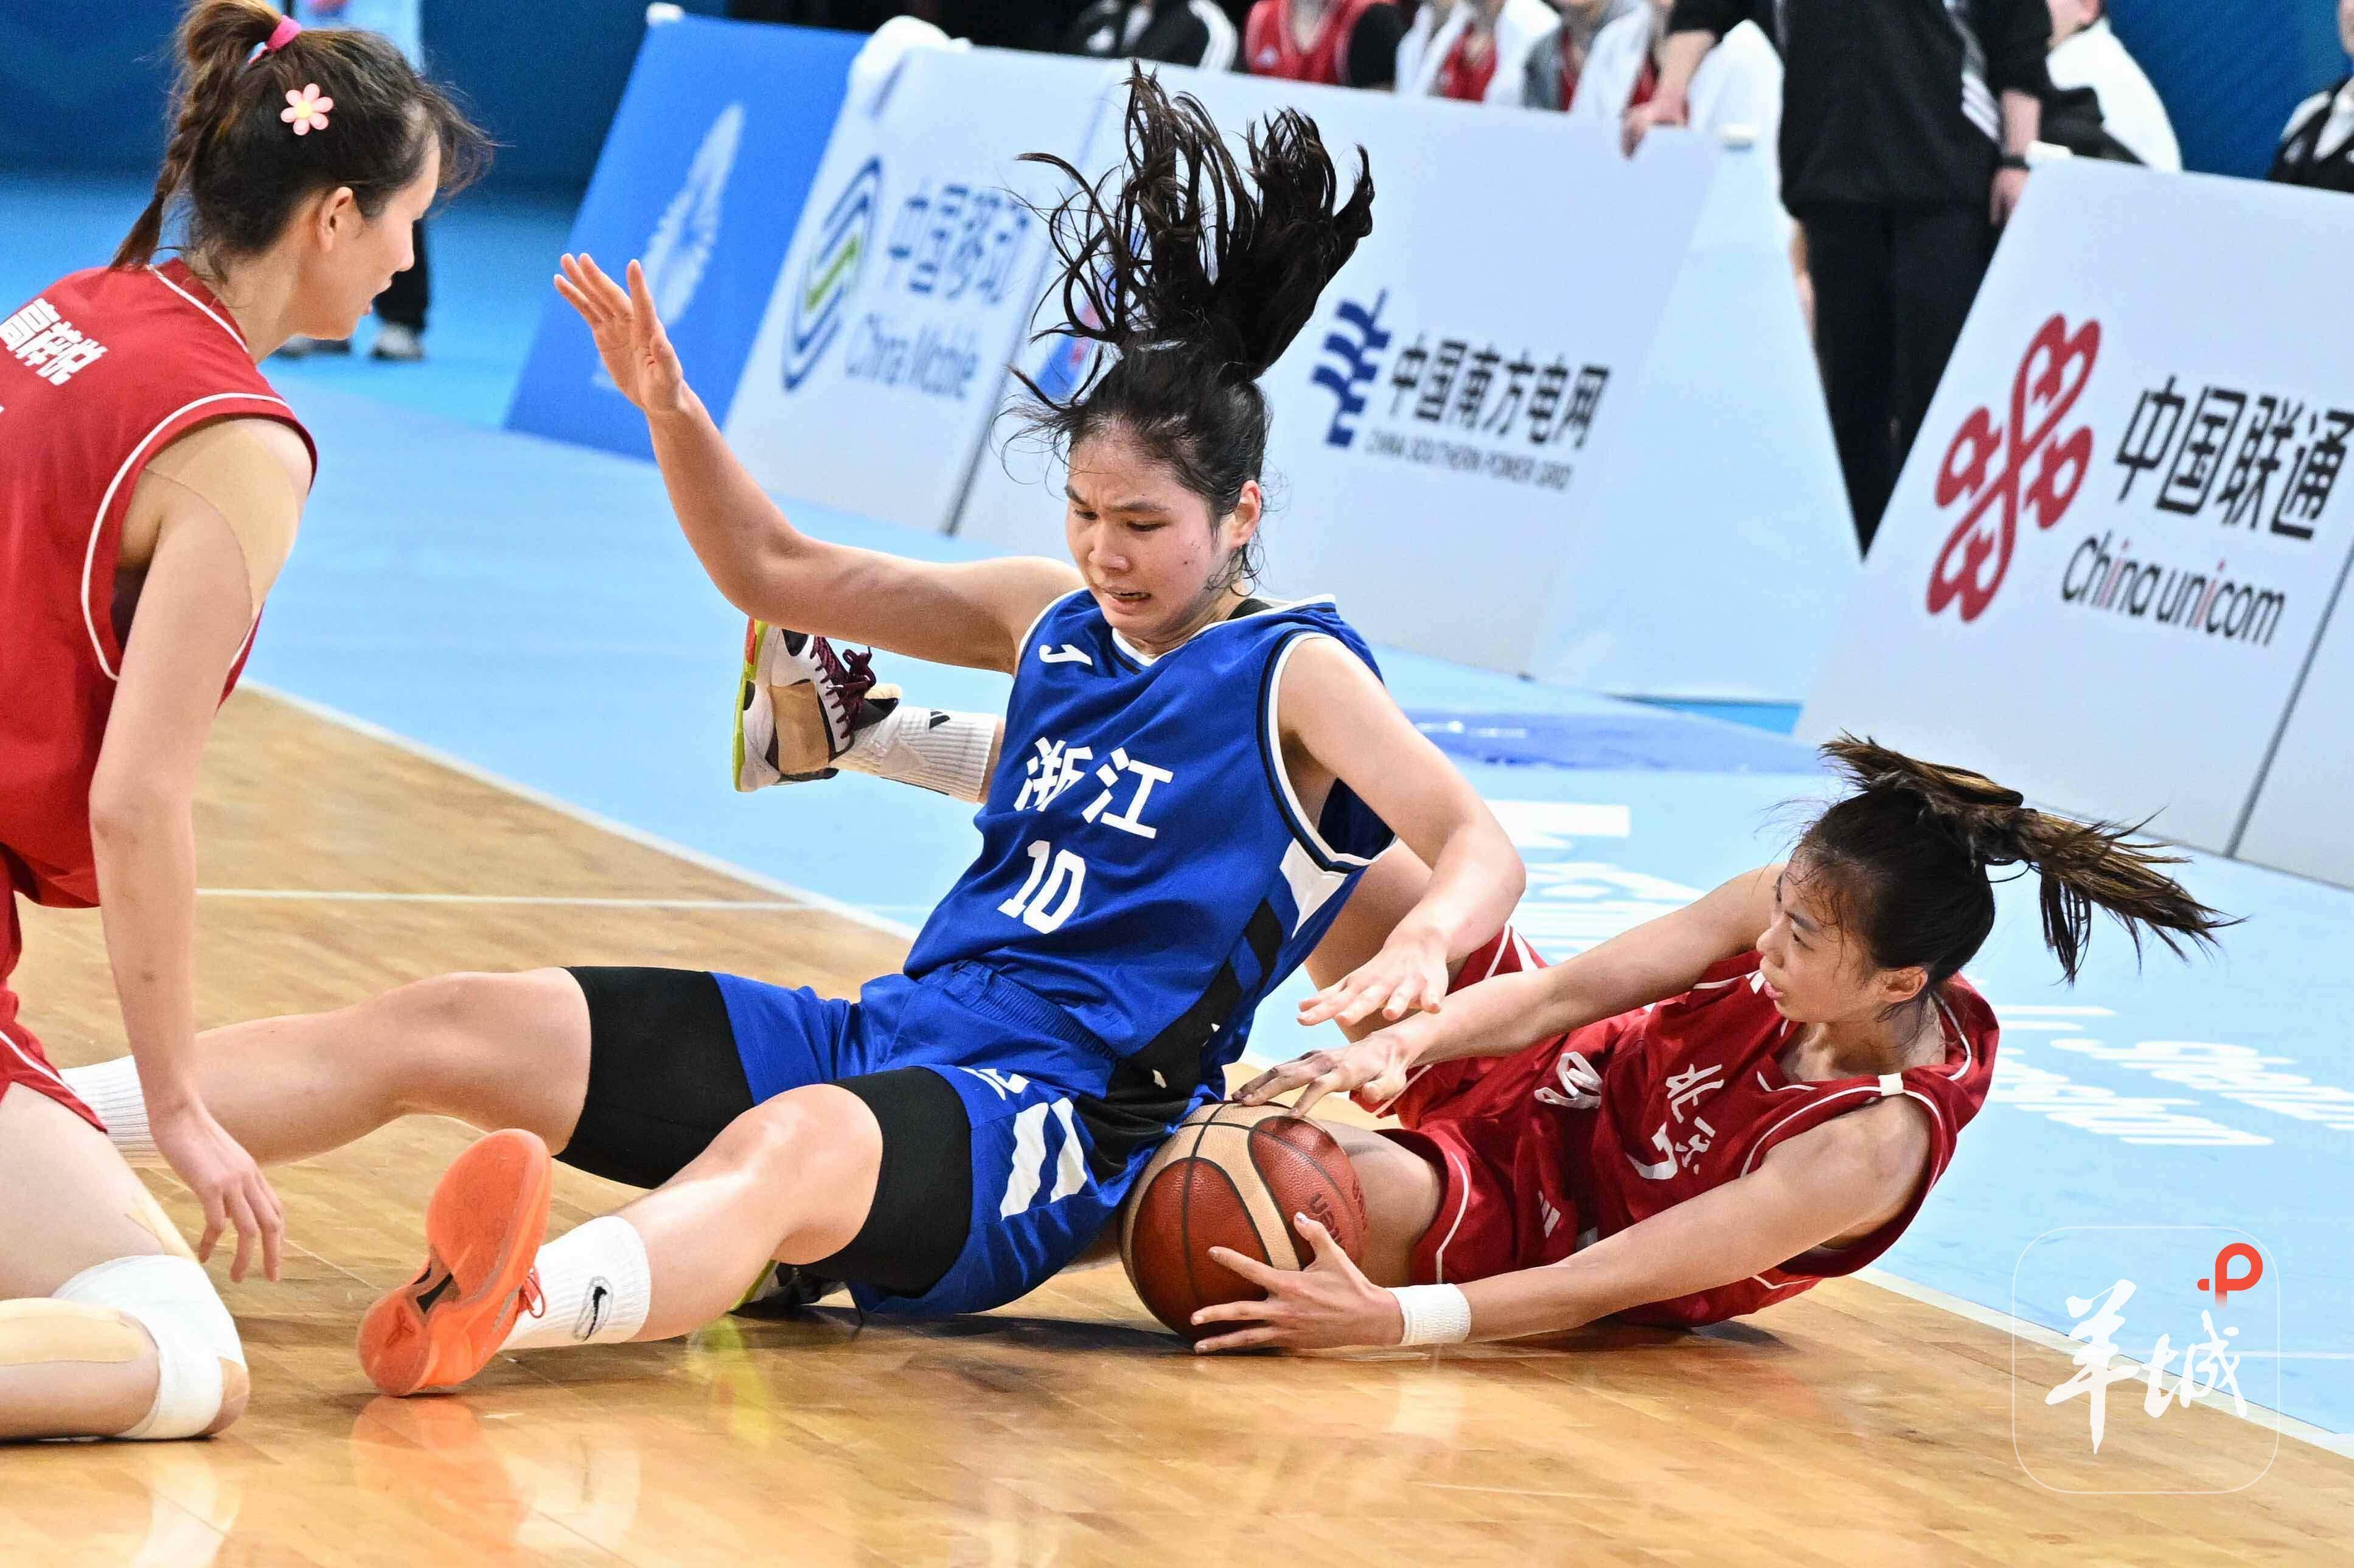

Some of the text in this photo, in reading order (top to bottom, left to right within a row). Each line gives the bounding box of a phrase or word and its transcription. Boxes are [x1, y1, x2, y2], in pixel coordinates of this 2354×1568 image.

[1389, 332, 1611, 449] 中国南方电网
[2115, 375, 2354, 540] 中国联通
[1014, 737, 1173, 838] 浙江
[998, 840, 1086, 935] 10
